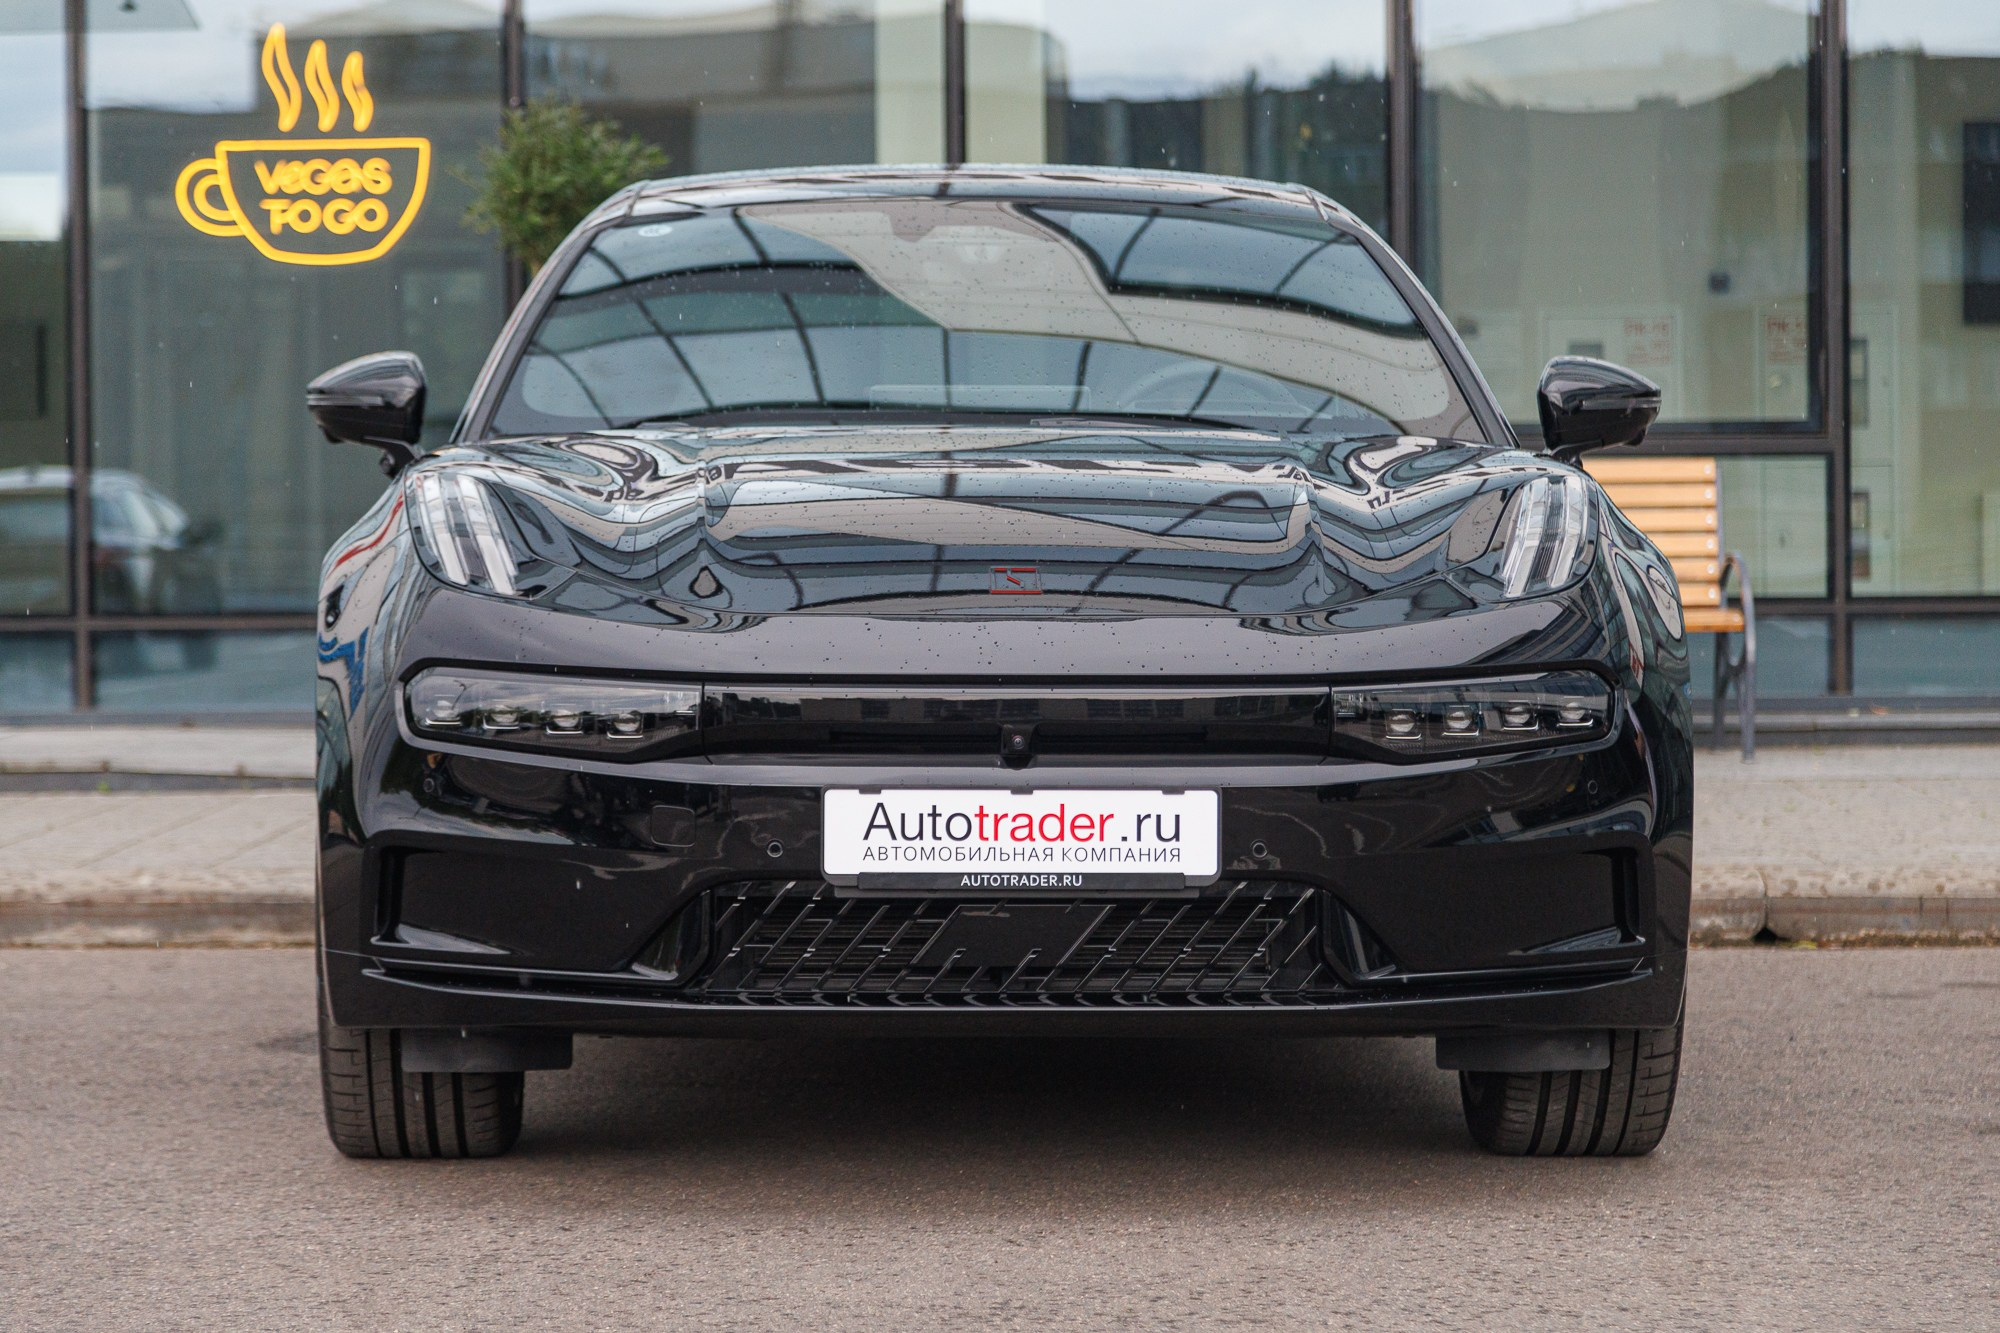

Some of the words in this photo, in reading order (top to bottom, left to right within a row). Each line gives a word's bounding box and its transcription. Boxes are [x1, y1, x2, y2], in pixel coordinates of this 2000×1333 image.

[863, 802, 1181, 842] Autotrader.ru
[863, 846, 1053, 862] АВТОМОБИЛЬНАЯ
[1062, 846, 1181, 862] КОМПАНИЯ
[961, 874, 1083, 887] AUTOTRADER.RU
